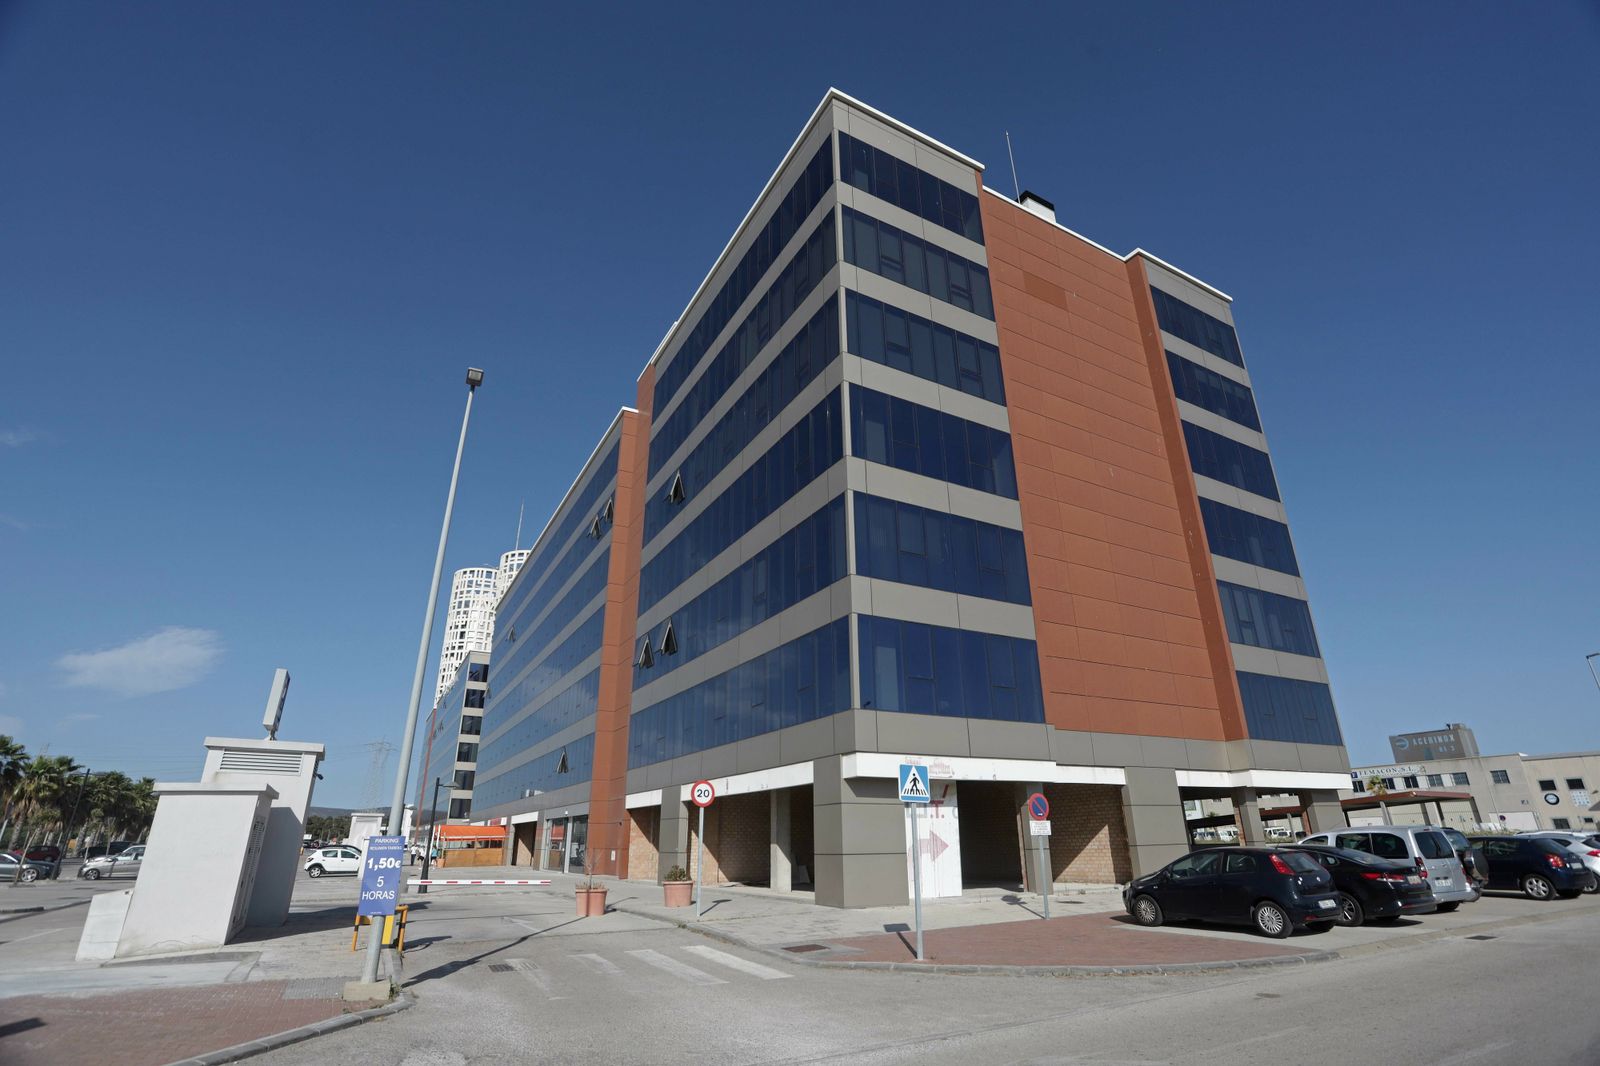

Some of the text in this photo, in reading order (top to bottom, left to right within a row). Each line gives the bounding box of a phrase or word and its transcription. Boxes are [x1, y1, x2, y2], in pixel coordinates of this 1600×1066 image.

[697, 789, 710, 798] 20
[367, 857, 401, 871] 1,50€
[376, 875, 385, 887] 5
[361, 890, 395, 900] HORAS
